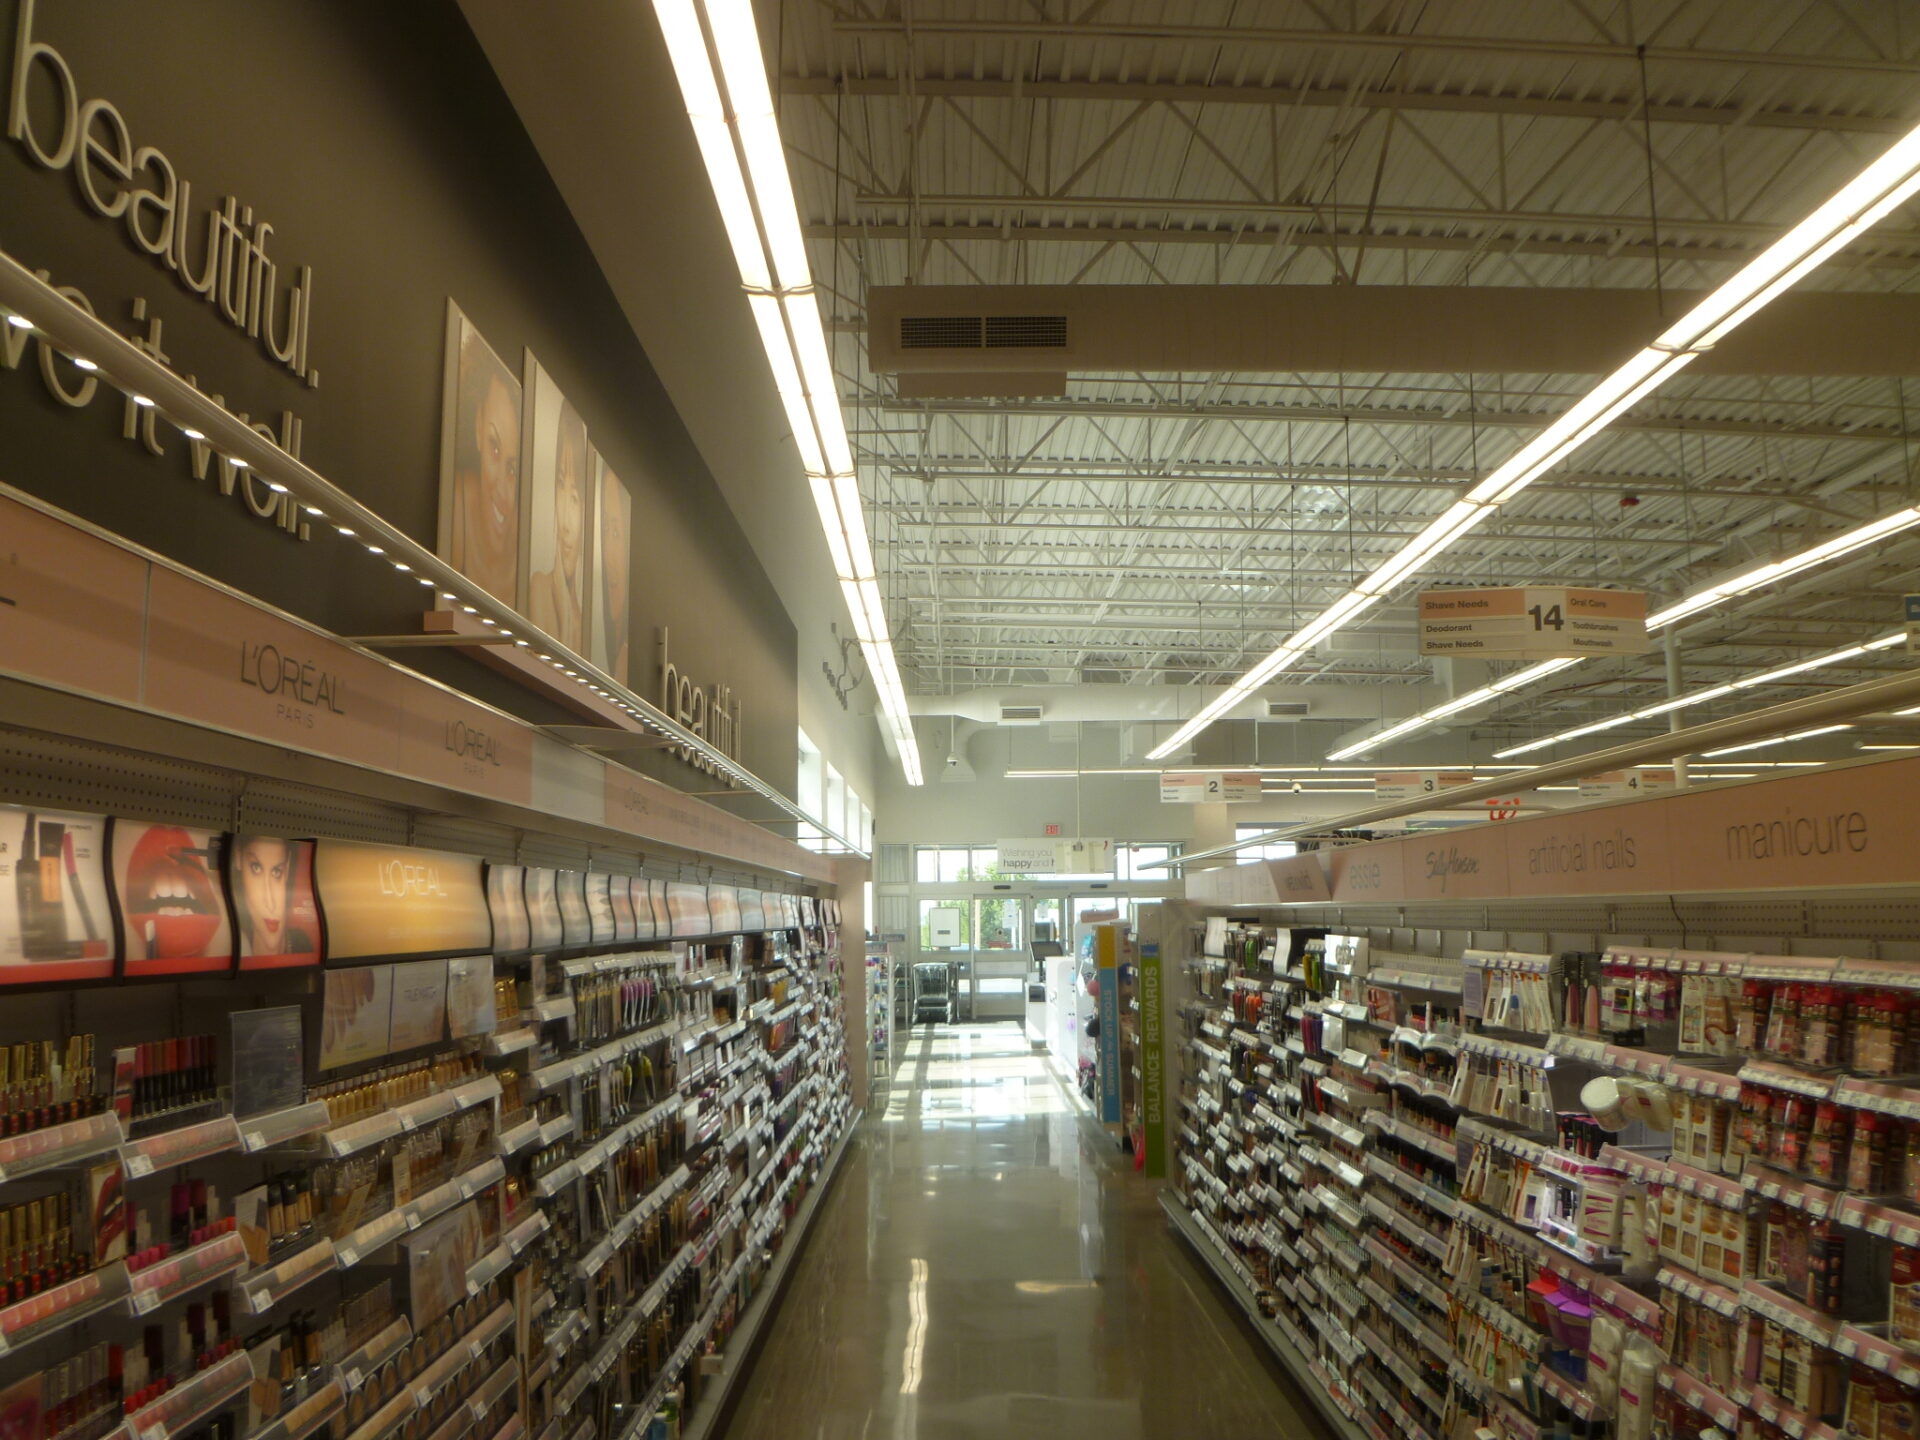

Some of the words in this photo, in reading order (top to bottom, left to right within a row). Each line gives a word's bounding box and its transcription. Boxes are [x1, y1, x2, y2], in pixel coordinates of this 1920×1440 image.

[123, 297, 171, 456] it
[1425, 601, 1455, 610] Shave
[1458, 599, 1489, 609] Needs
[1528, 604, 1565, 631] 14
[1426, 624, 1473, 633] Deodorant
[1426, 641, 1454, 650] Shave
[1455, 639, 1484, 648] Needs
[240, 640, 345, 715] L'ORÉAL
[276, 703, 315, 729] PARIS
[1208, 781, 1219, 793] 2
[1424, 779, 1434, 792] 3
[1628, 776, 1638, 789] 4
[1727, 807, 1868, 860] manicure
[1593, 828, 1637, 871] nails
[1003, 858, 1033, 869] happy
[1145, 966, 1158, 1041] REWARDS
[1148, 1050, 1161, 1123] BALANCE
